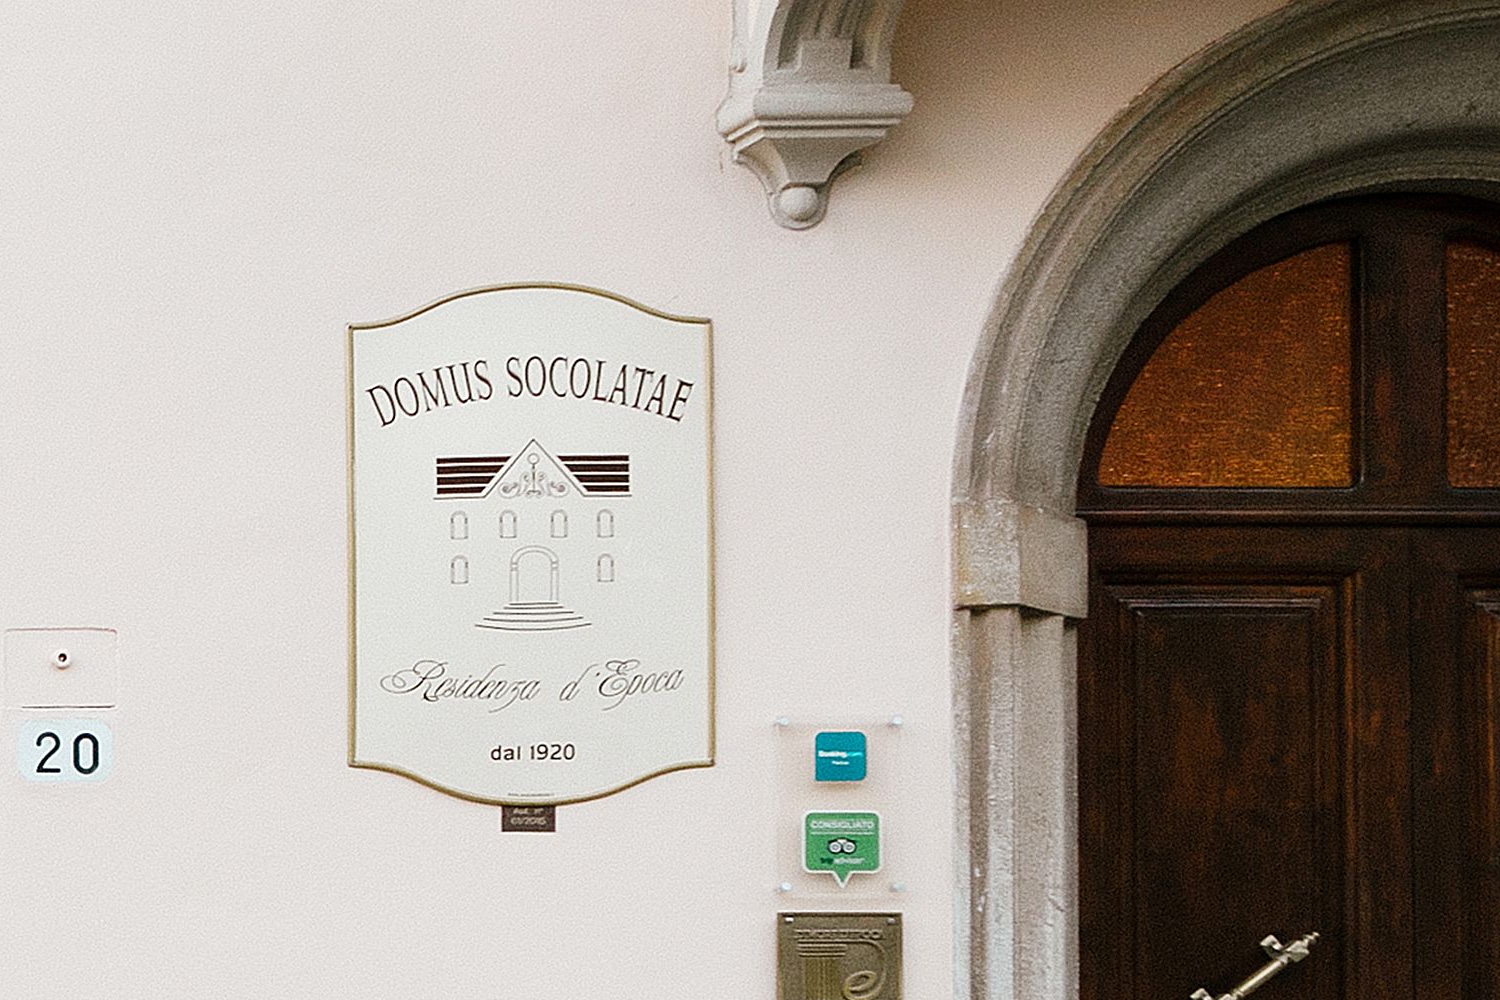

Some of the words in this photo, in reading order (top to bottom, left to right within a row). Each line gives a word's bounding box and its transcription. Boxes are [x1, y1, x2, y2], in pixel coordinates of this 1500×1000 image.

[365, 359, 493, 428] DOMUS
[505, 355, 694, 423] SOCOLATAE
[380, 659, 541, 713] Residenza
[35, 731, 100, 775] 20
[490, 743, 521, 761] dal
[530, 743, 576, 761] 1920
